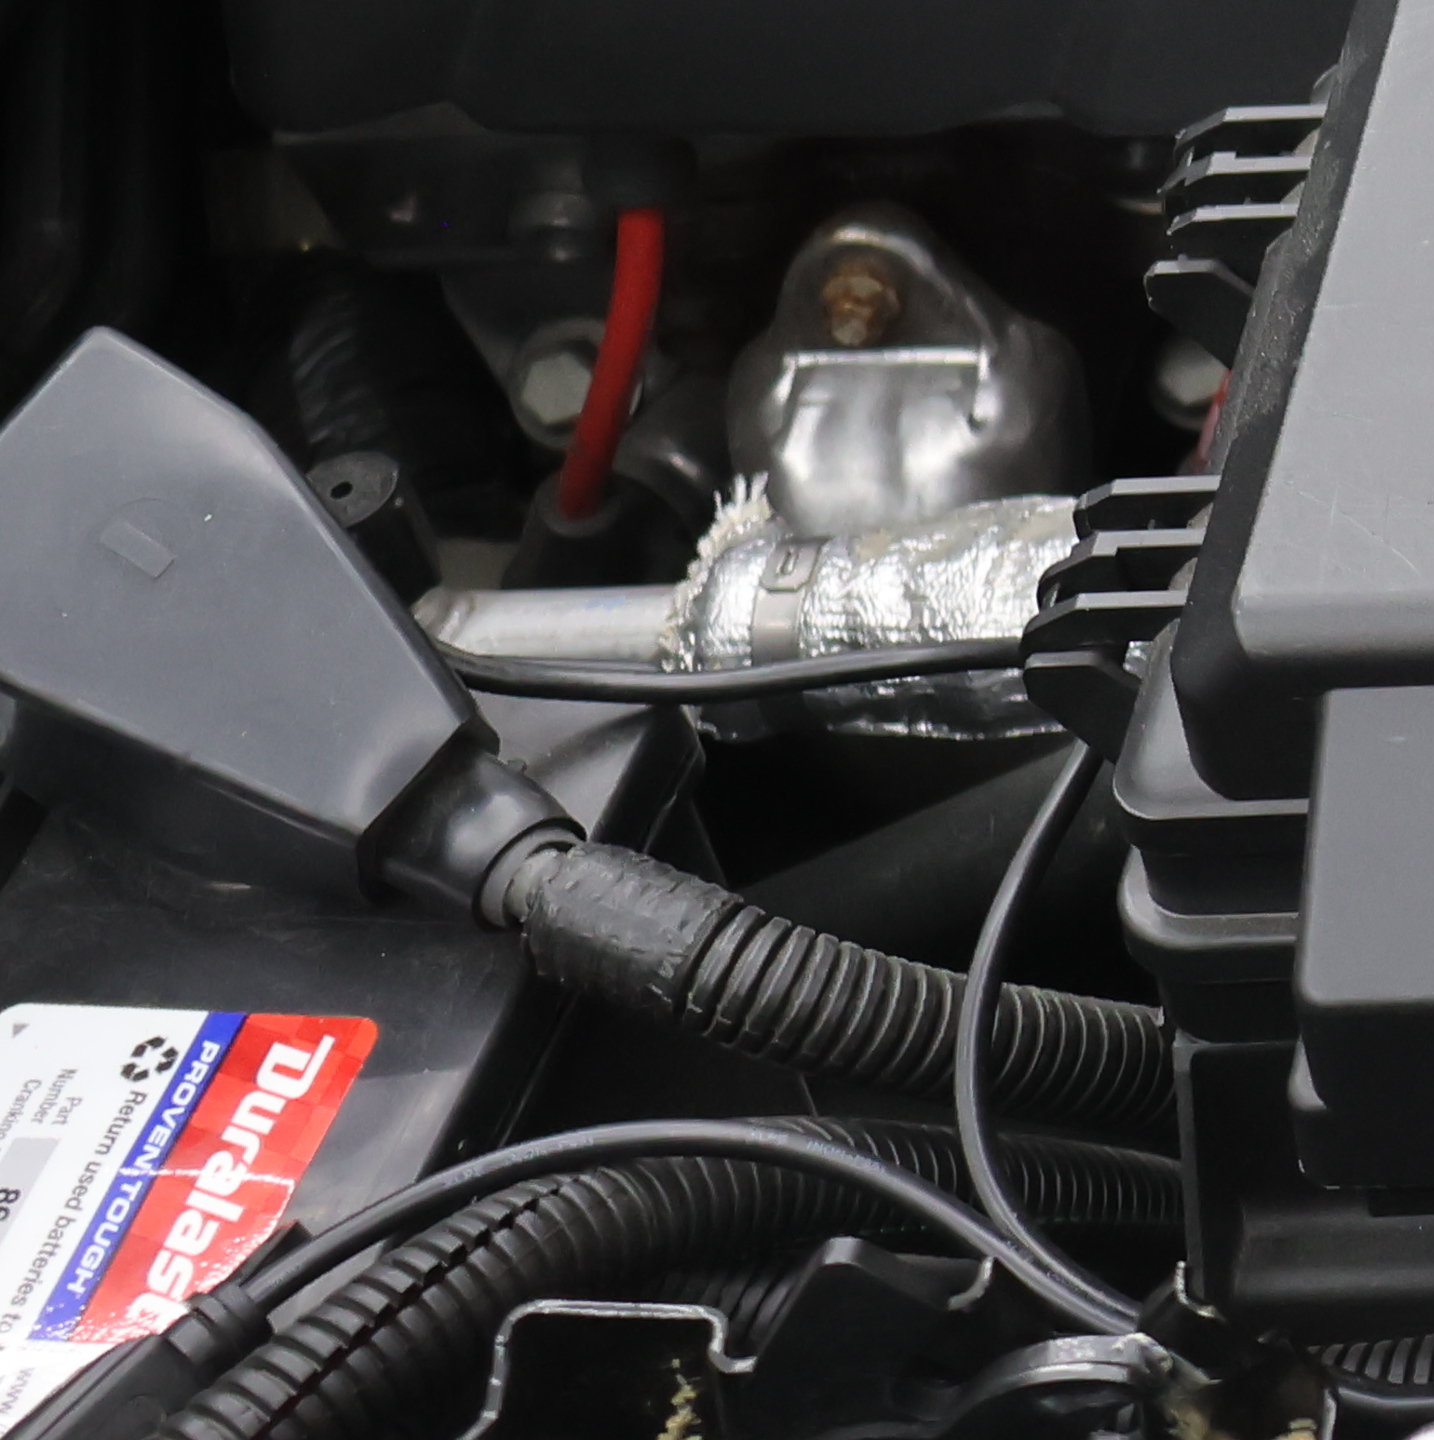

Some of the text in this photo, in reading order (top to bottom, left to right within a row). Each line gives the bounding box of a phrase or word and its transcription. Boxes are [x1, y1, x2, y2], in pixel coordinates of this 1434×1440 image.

[31, 1069, 78, 1123] Number
[51, 1096, 82, 1125] Part
[94, 1090, 148, 1155] Return
[65, 1161, 102, 1211] used
[66, 1040, 221, 1294] PROVEN TOUGH
[125, 1034, 336, 1334] Duralast
[11, 1215, 78, 1307] batteries
